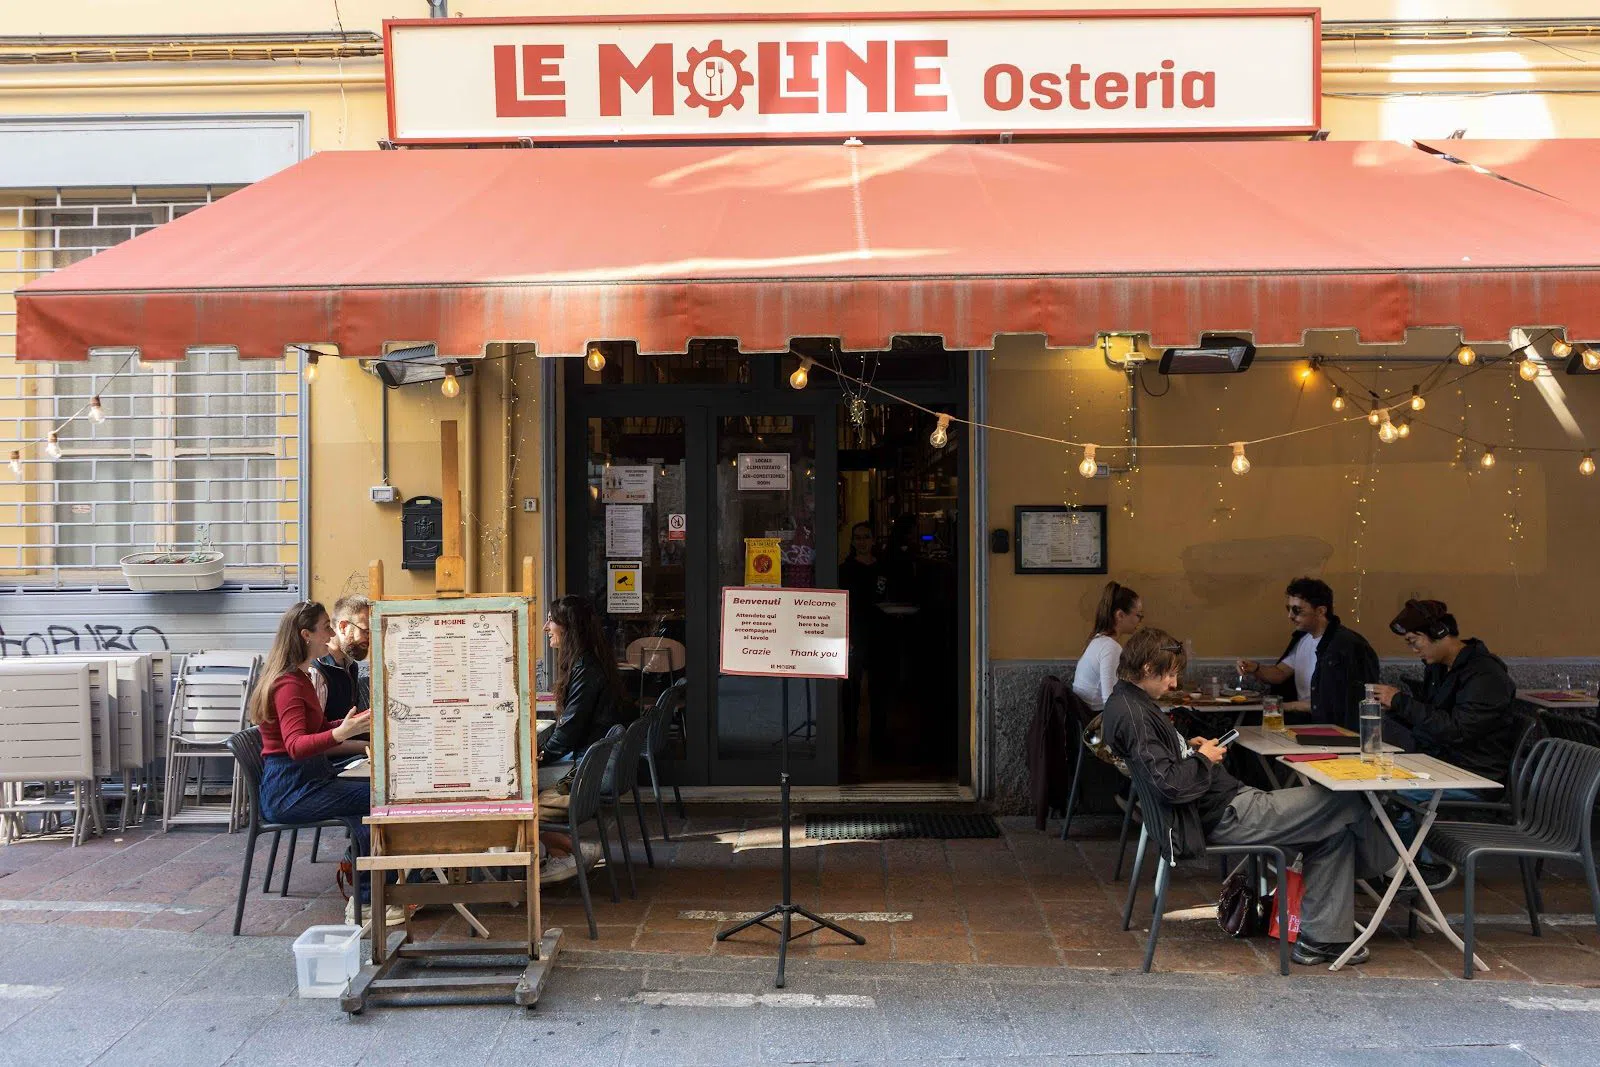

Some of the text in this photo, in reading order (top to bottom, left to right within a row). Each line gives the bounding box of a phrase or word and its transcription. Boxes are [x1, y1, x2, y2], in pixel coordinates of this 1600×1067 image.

[494, 39, 1215, 118] LE MOLINE Osteria
[732, 597, 781, 606] Benvenuti
[793, 598, 837, 607] Welcome
[742, 647, 771, 656] Grazie
[790, 649, 838, 659] Thank you
